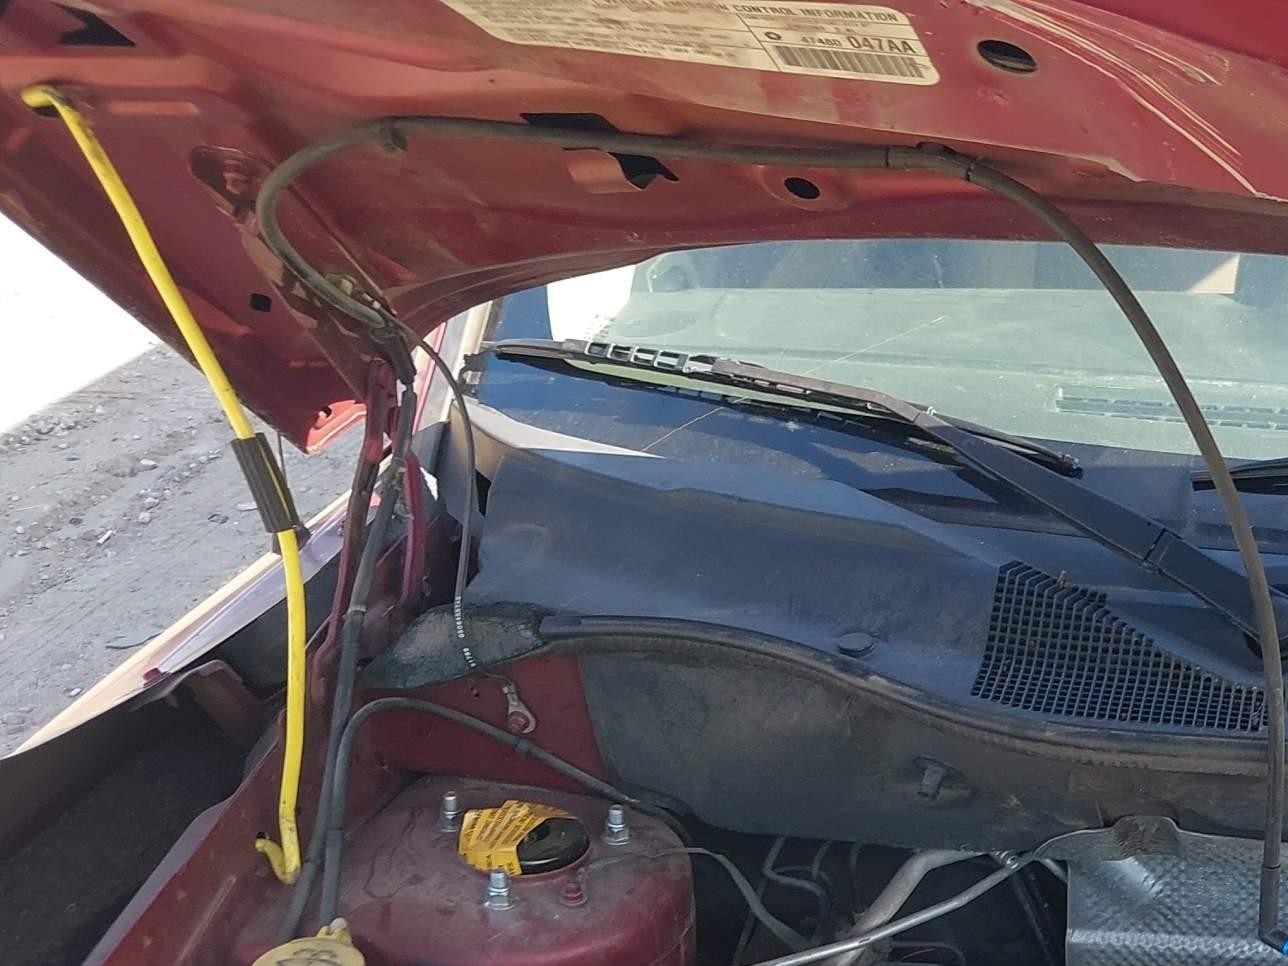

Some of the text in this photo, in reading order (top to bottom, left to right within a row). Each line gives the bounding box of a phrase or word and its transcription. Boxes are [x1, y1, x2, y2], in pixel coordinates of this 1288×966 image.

[735, 4, 796, 16] CONTROL
[801, 8, 898, 22] INFORMATION
[848, 36, 917, 54] 047AA
